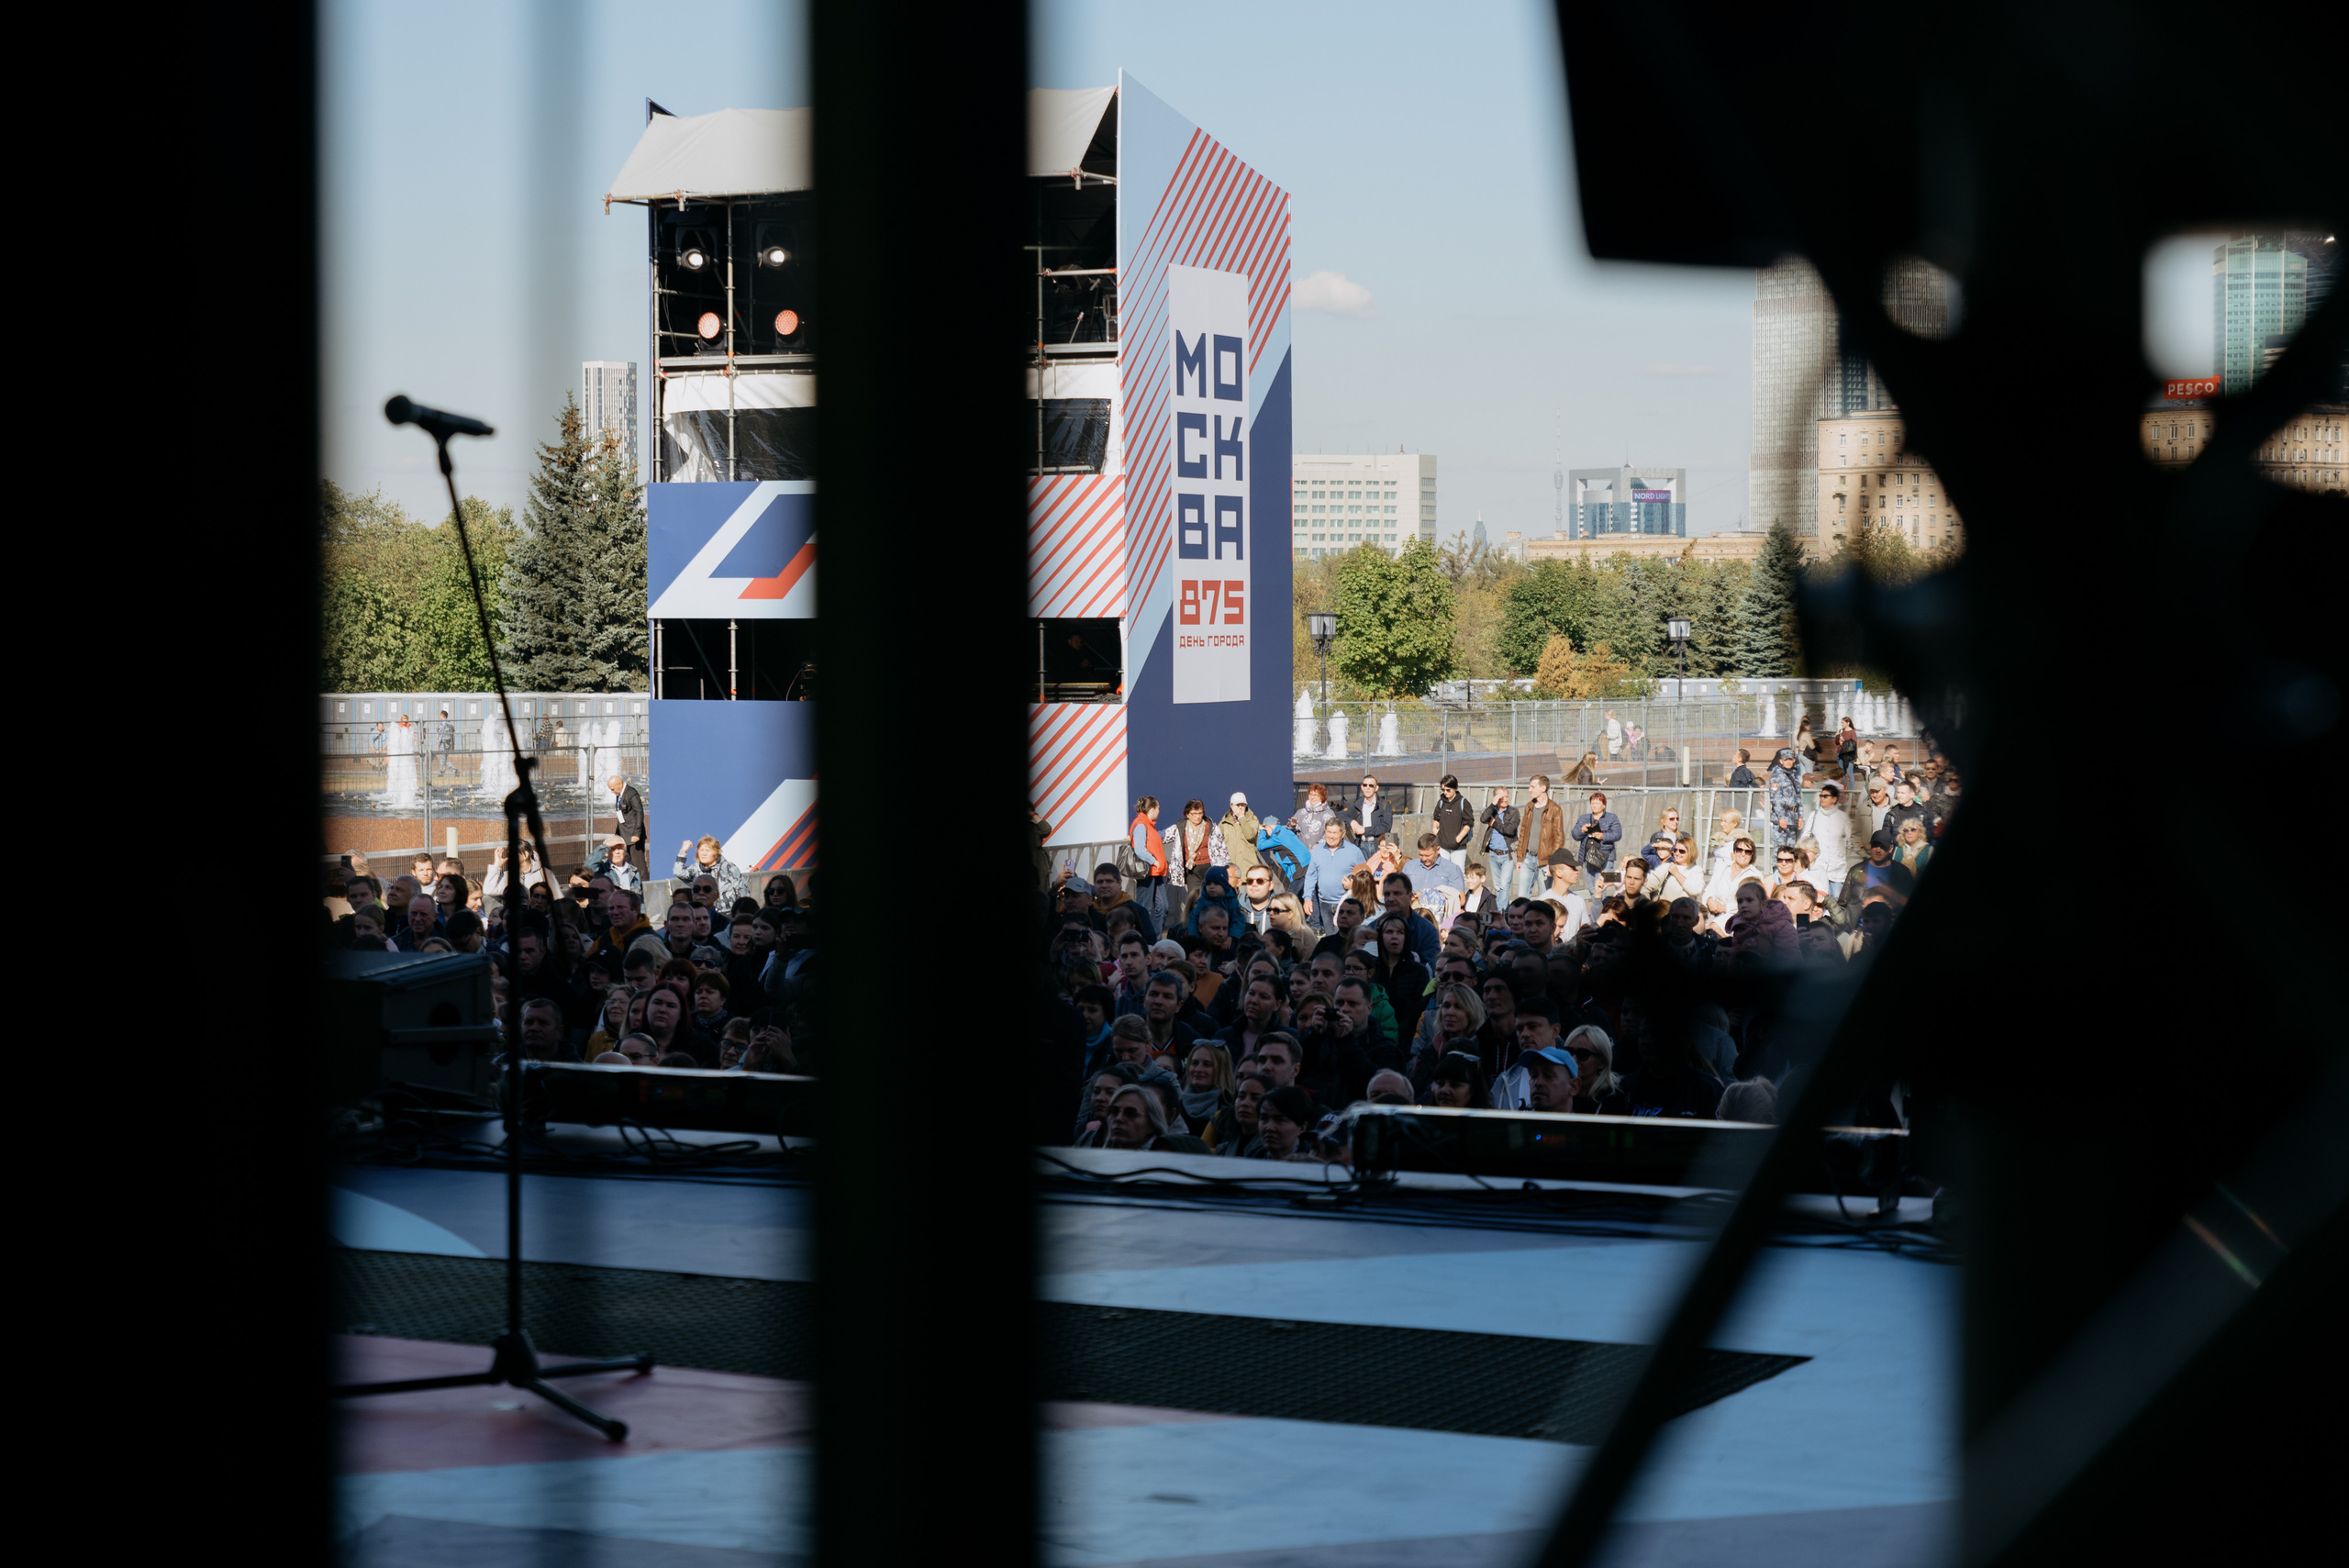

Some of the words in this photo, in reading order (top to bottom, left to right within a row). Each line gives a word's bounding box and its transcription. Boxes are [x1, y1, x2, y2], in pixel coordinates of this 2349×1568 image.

[1175, 329, 1243, 401] МО
[1177, 411, 1243, 481] СК
[1178, 494, 1243, 561] ВА
[1180, 580, 1244, 625] 875
[1179, 635, 1205, 649] ДЕНЬ
[1208, 635, 1244, 648] ГОРОДА
